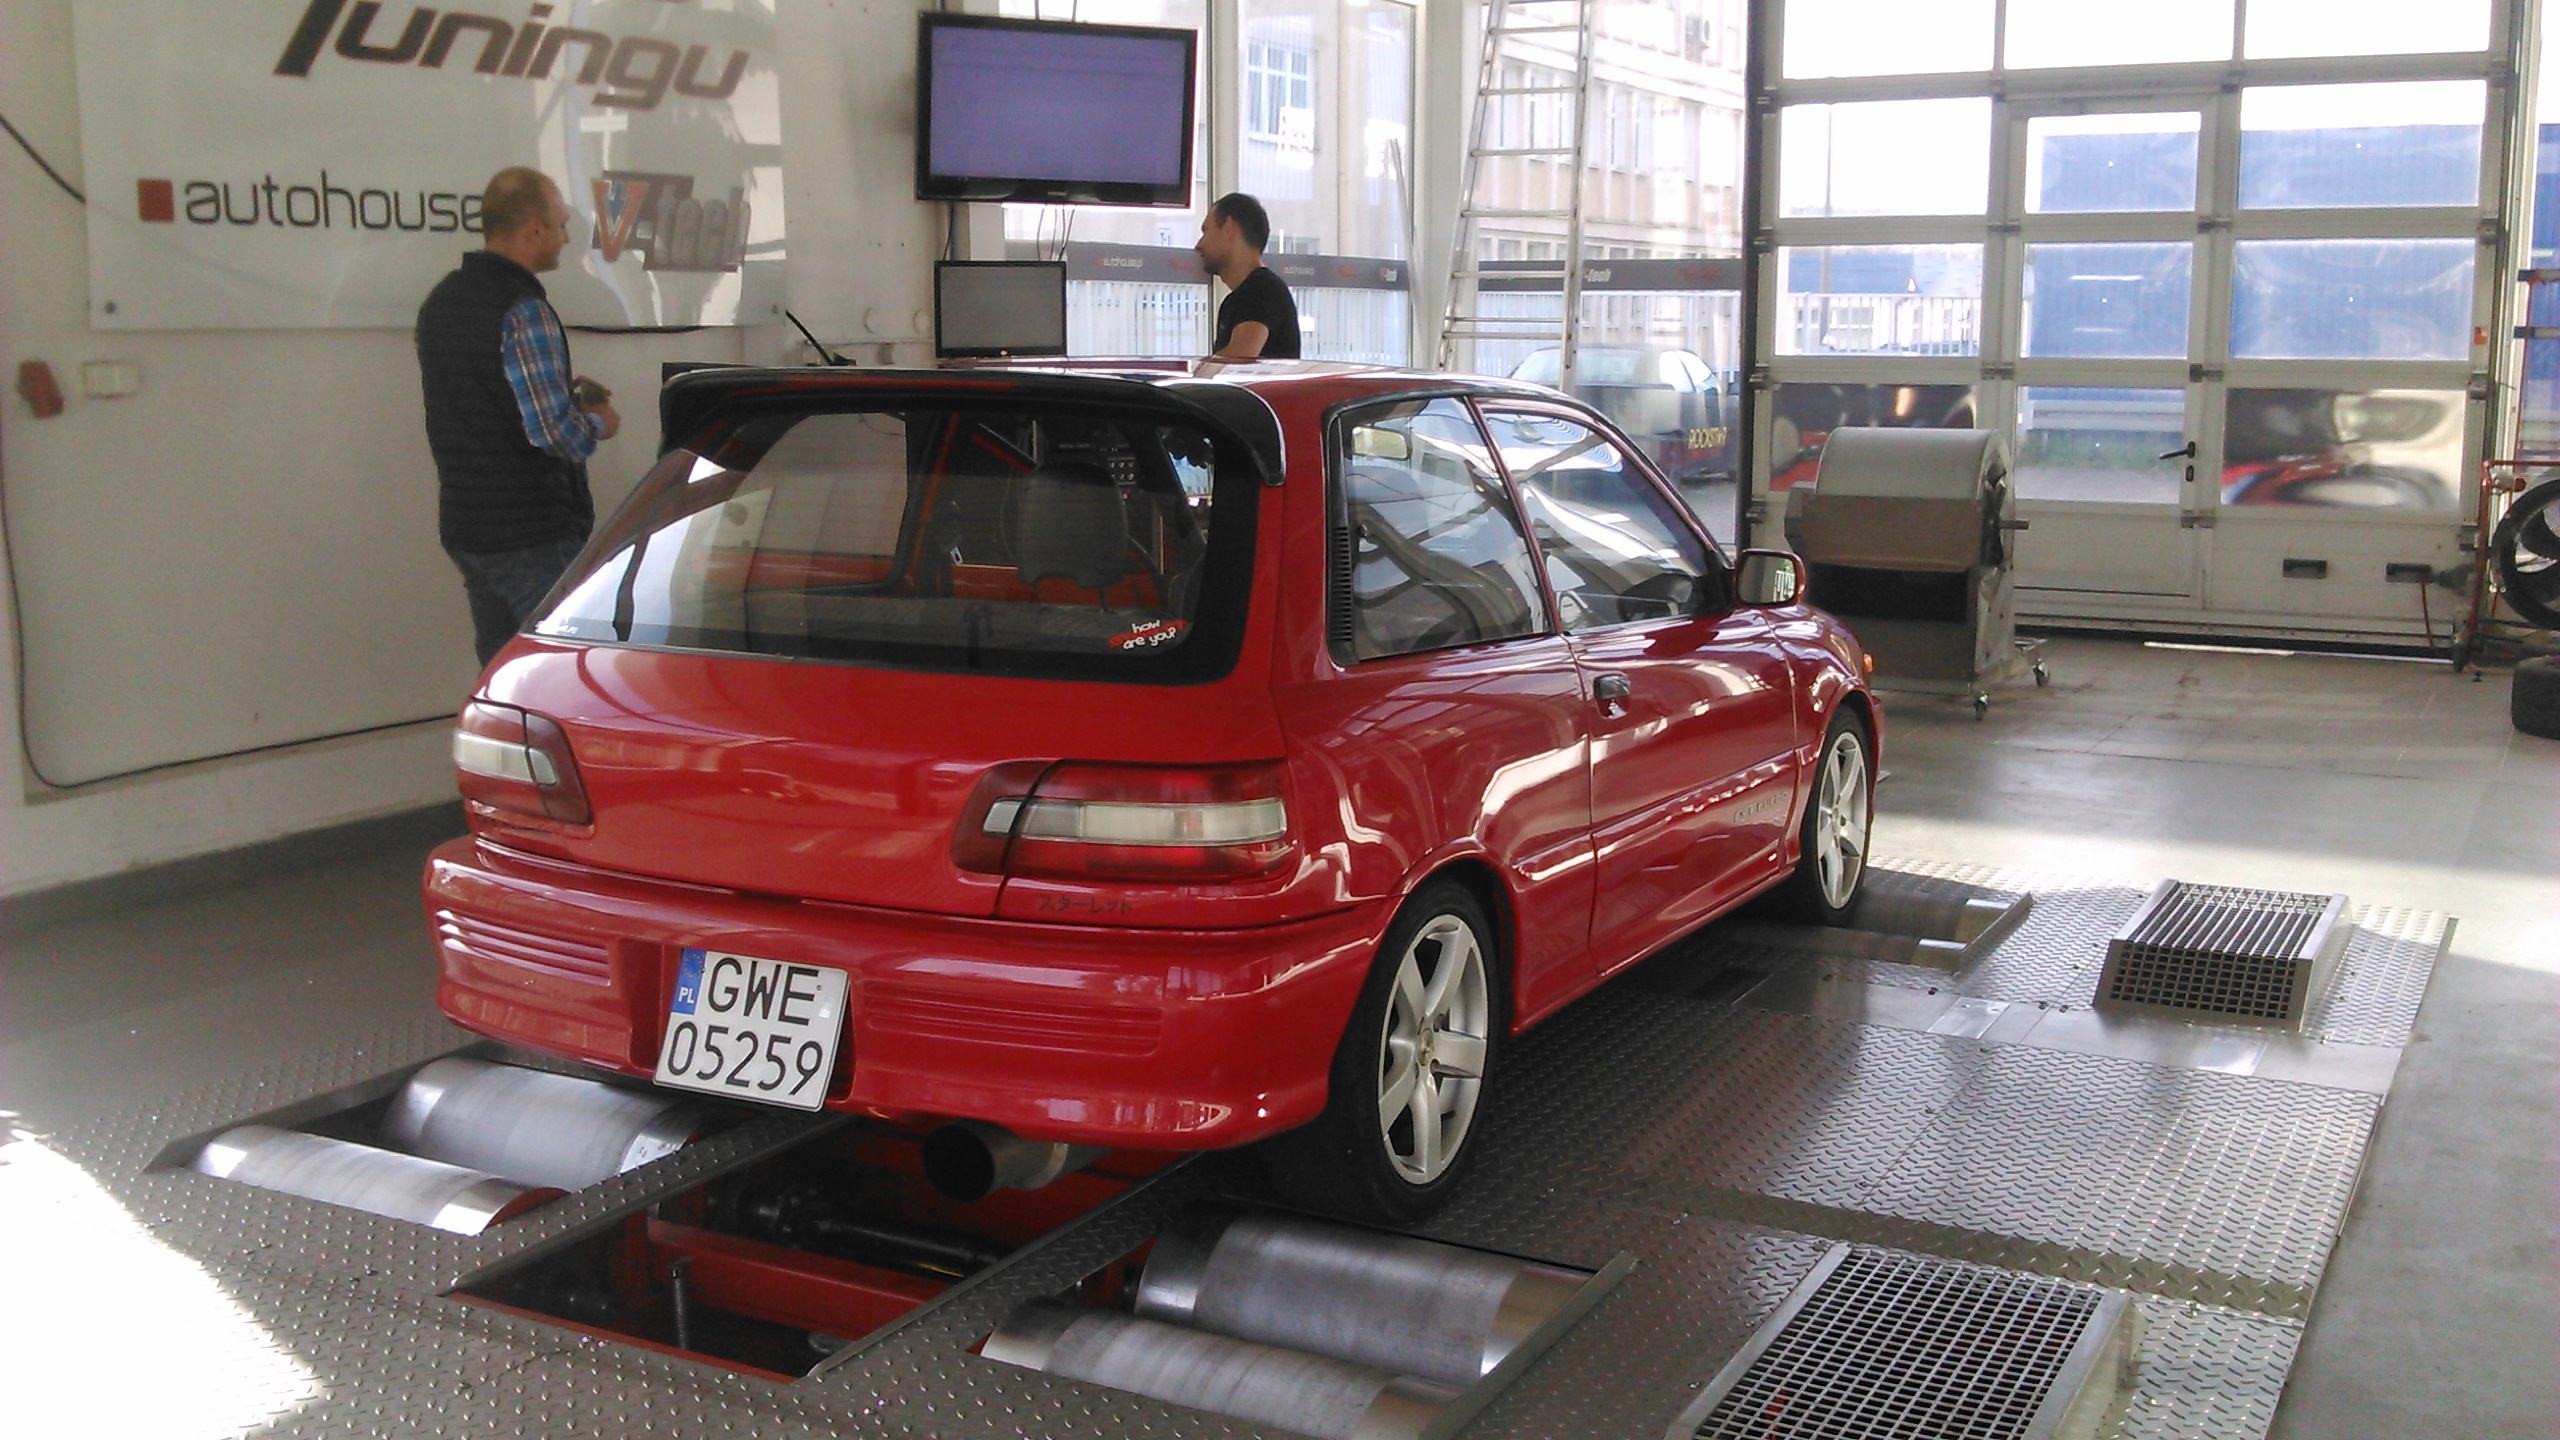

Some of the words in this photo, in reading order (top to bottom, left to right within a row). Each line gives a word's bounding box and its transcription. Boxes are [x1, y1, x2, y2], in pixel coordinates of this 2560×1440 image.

[1132, 620, 1160, 633] how
[1123, 637, 1146, 650] are
[1149, 627, 1177, 646] you?
[1038, 894, 1133, 915] スターレット
[678, 986, 695, 1004] PL
[708, 957, 819, 1026] GWE
[667, 1021, 823, 1096] 05259
